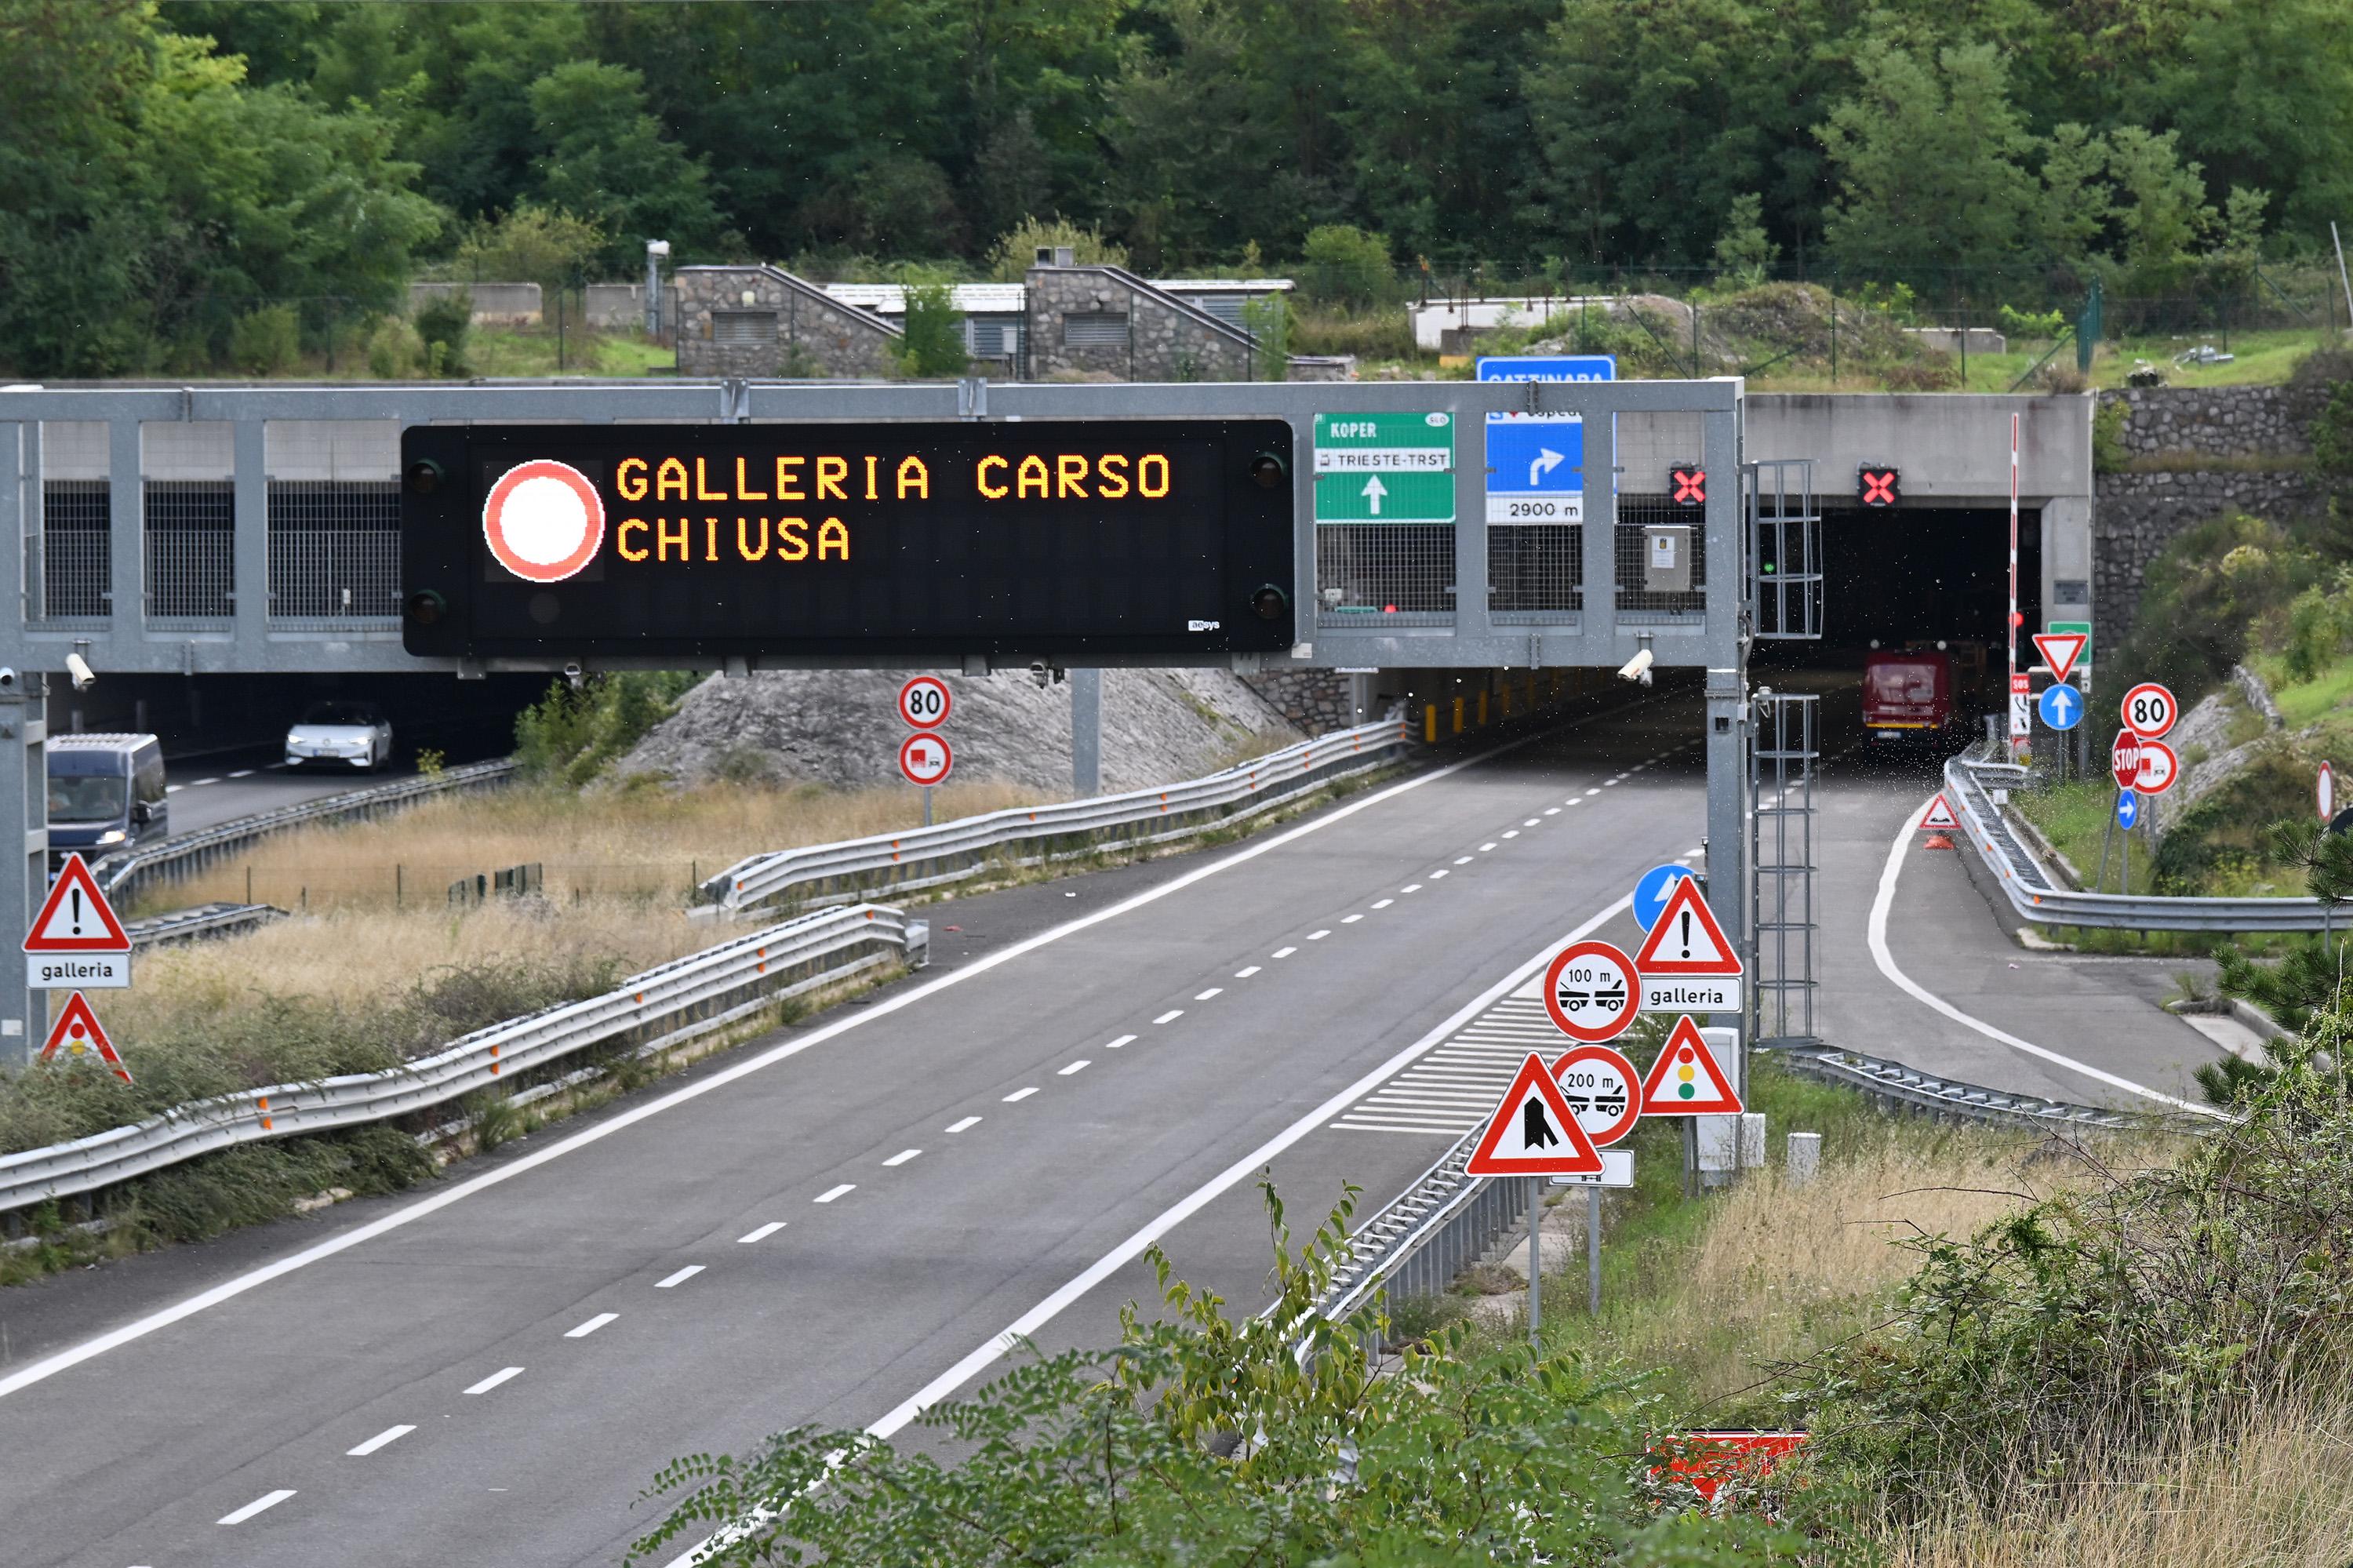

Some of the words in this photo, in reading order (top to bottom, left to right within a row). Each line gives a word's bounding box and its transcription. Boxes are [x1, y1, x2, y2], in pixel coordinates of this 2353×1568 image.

[1330, 422, 1377, 438] KOPER
[1338, 454, 1447, 467] TRIESTE-TRST
[617, 456, 928, 500] GALLERIA
[977, 454, 1170, 499] CARSO
[1510, 503, 1555, 517] 2900
[1565, 506, 1579, 516] m
[617, 517, 849, 562] CHIUSA
[1192, 620, 1220, 631] aesys
[2012, 678, 2029, 690] SOS
[911, 689, 940, 715] 80
[2134, 697, 2165, 724] 80
[2115, 748, 2140, 772] STOP
[42, 962, 114, 981] galleria
[1569, 969, 1592, 983] 100
[1600, 972, 1611, 983] m
[1650, 988, 1724, 1006] galleria
[1568, 1073, 1595, 1088] 200
[1602, 1077, 1613, 1089] m
